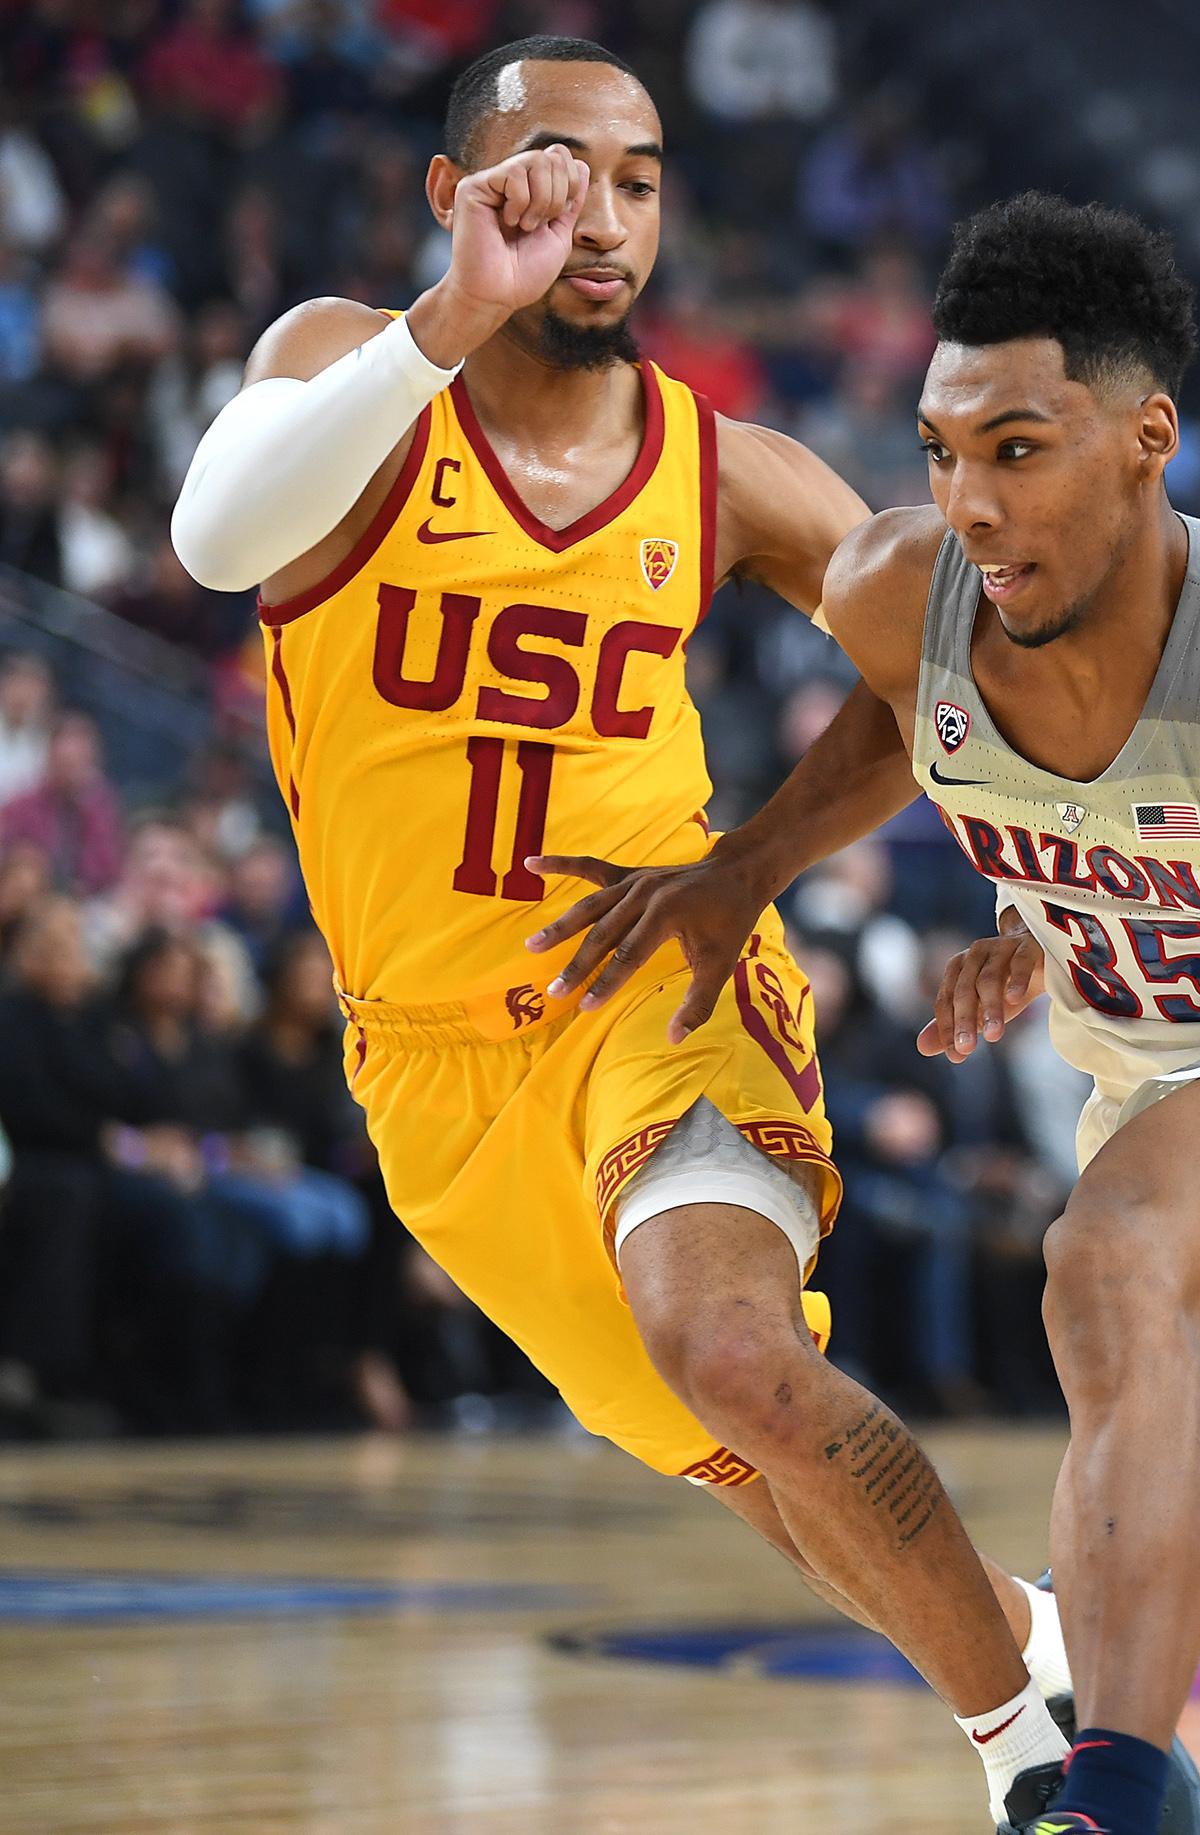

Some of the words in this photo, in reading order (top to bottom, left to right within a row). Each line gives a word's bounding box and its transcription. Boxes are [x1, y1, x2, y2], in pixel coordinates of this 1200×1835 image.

[430, 457, 461, 508] C
[643, 541, 675, 571] PAC
[648, 561, 667, 580] 12
[372, 582, 683, 739] USC
[936, 704, 968, 740] PAC
[941, 724, 959, 746] 12
[452, 735, 555, 902] 11
[1062, 805, 1080, 824] A
